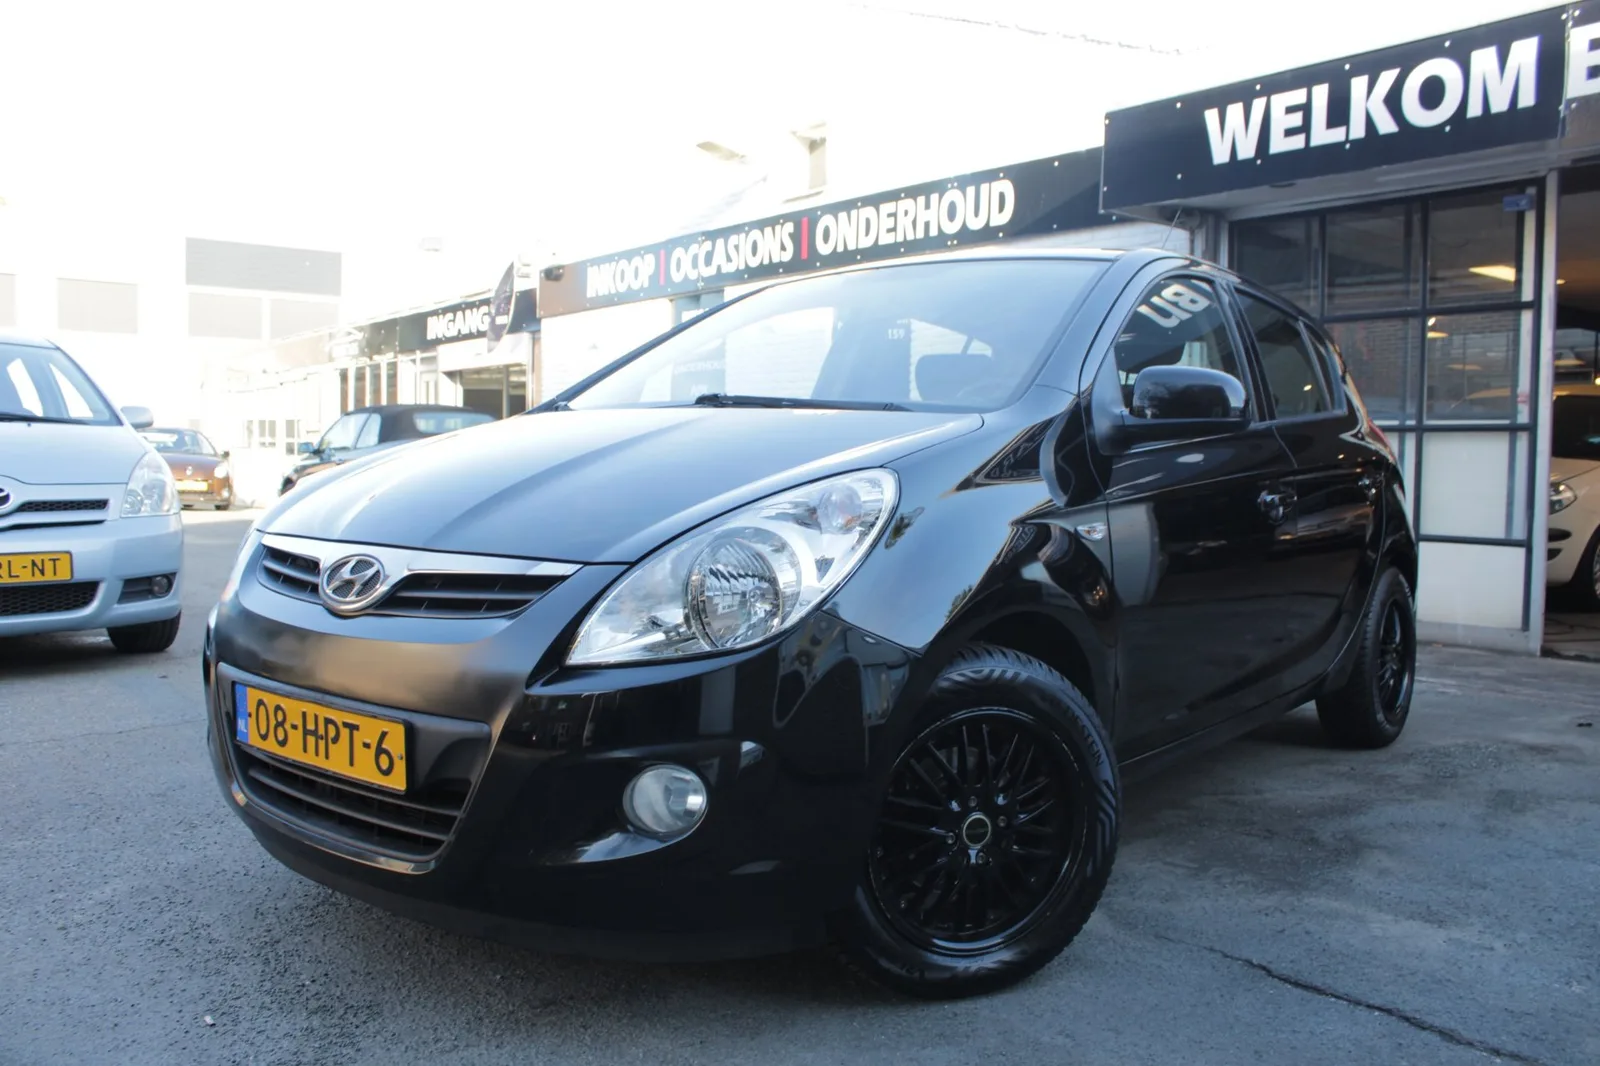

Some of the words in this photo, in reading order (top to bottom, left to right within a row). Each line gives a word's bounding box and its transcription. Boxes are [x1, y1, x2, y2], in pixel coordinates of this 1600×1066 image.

[1204, 34, 1541, 166] WELKOM
[586, 253, 656, 298] INKOOP
[669, 221, 795, 283] OCCASIONS
[815, 179, 1015, 256] ONDERHOUD
[426, 305, 491, 340] INGANG
[255, 698, 395, 777] 08-HPT-6
